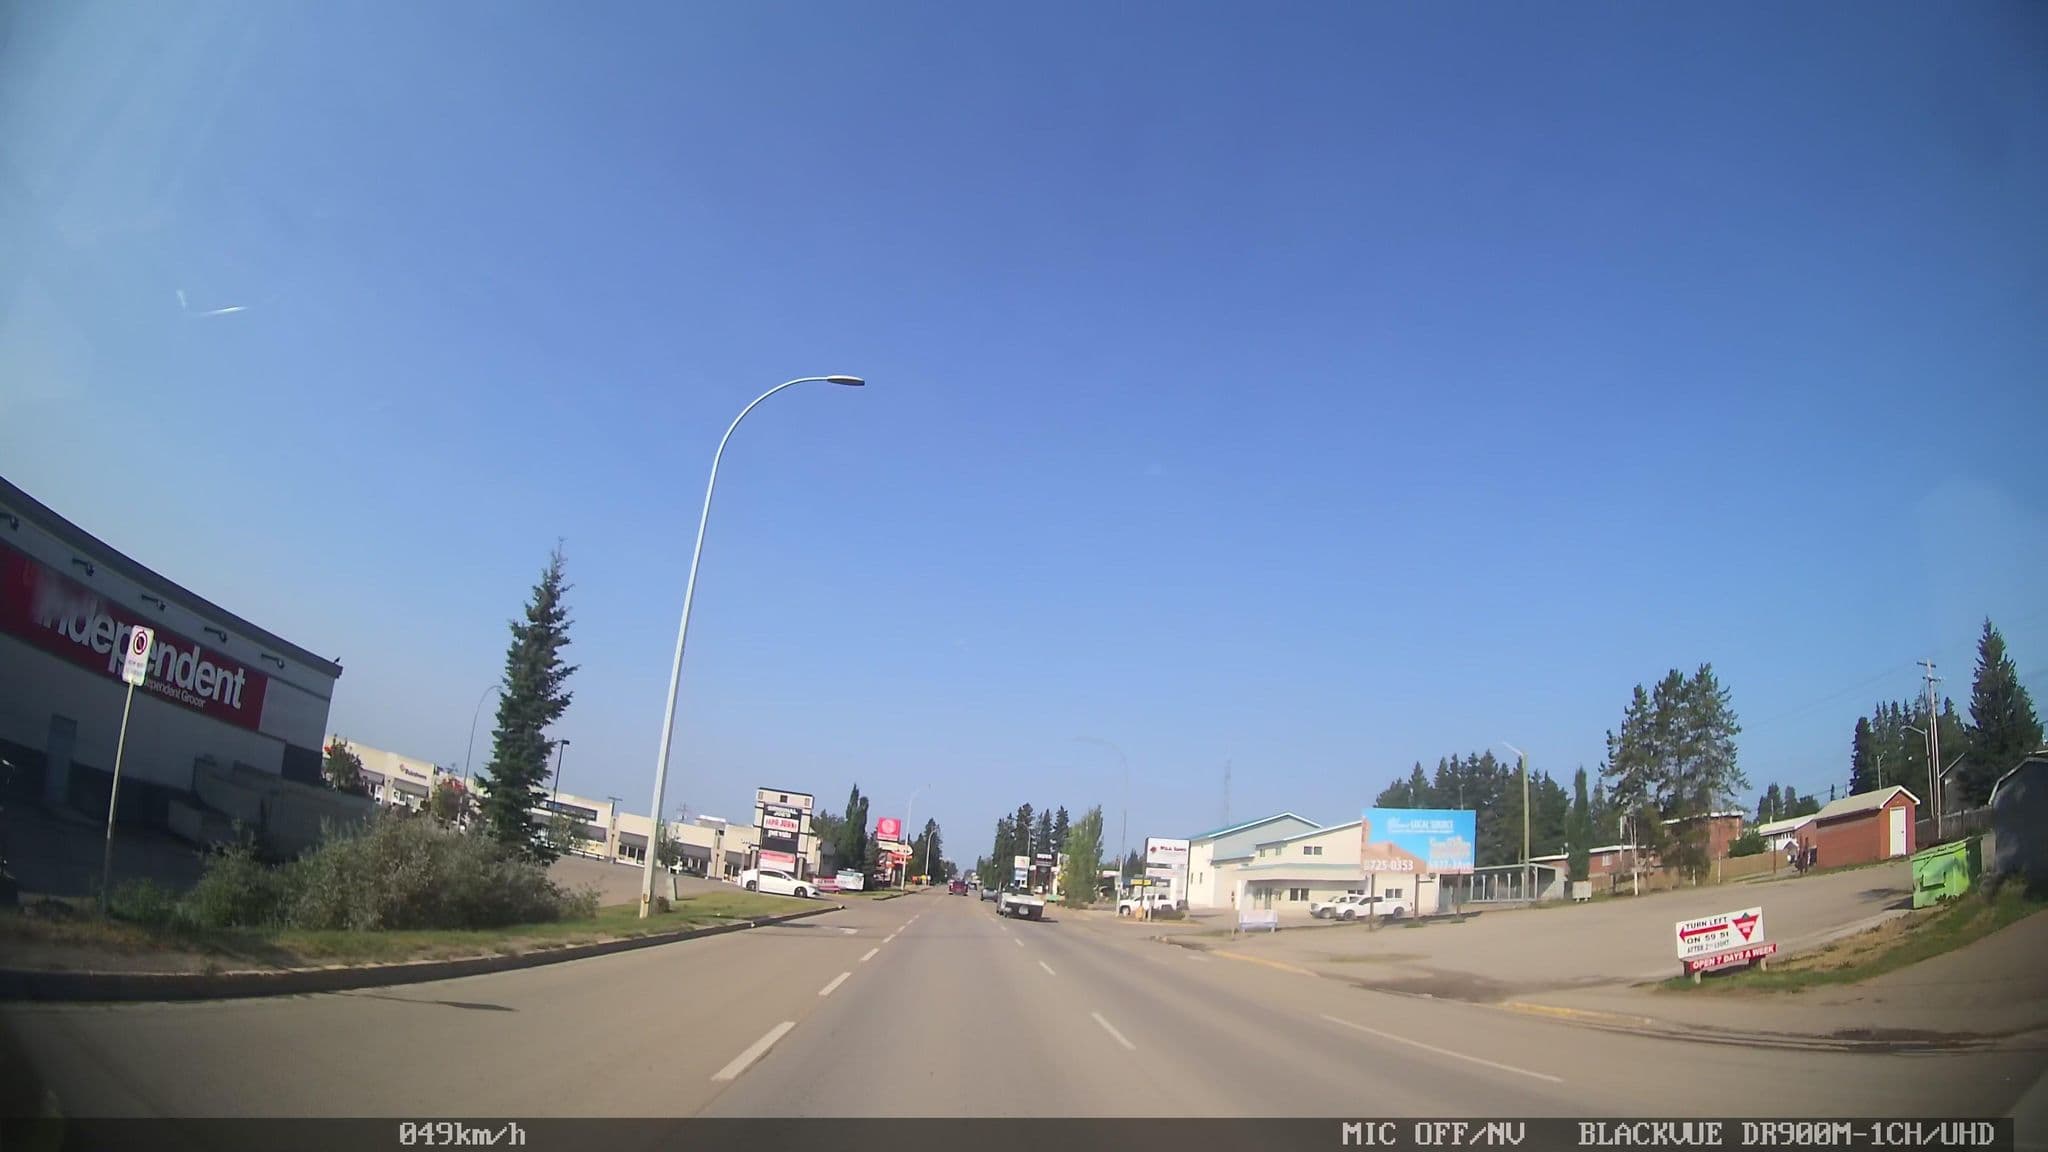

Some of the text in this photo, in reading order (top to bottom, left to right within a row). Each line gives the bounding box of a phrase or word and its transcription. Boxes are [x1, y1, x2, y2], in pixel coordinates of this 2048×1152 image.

[1685, 920, 1707, 930] TURN
[1709, 916, 1728, 927] LEFT
[1686, 936, 1701, 944] ON
[1692, 957, 1716, 969] OPEN
[1723, 951, 1744, 963] DAYS
[1745, 950, 1752, 958] A
[1752, 945, 1775, 957] WEEK
